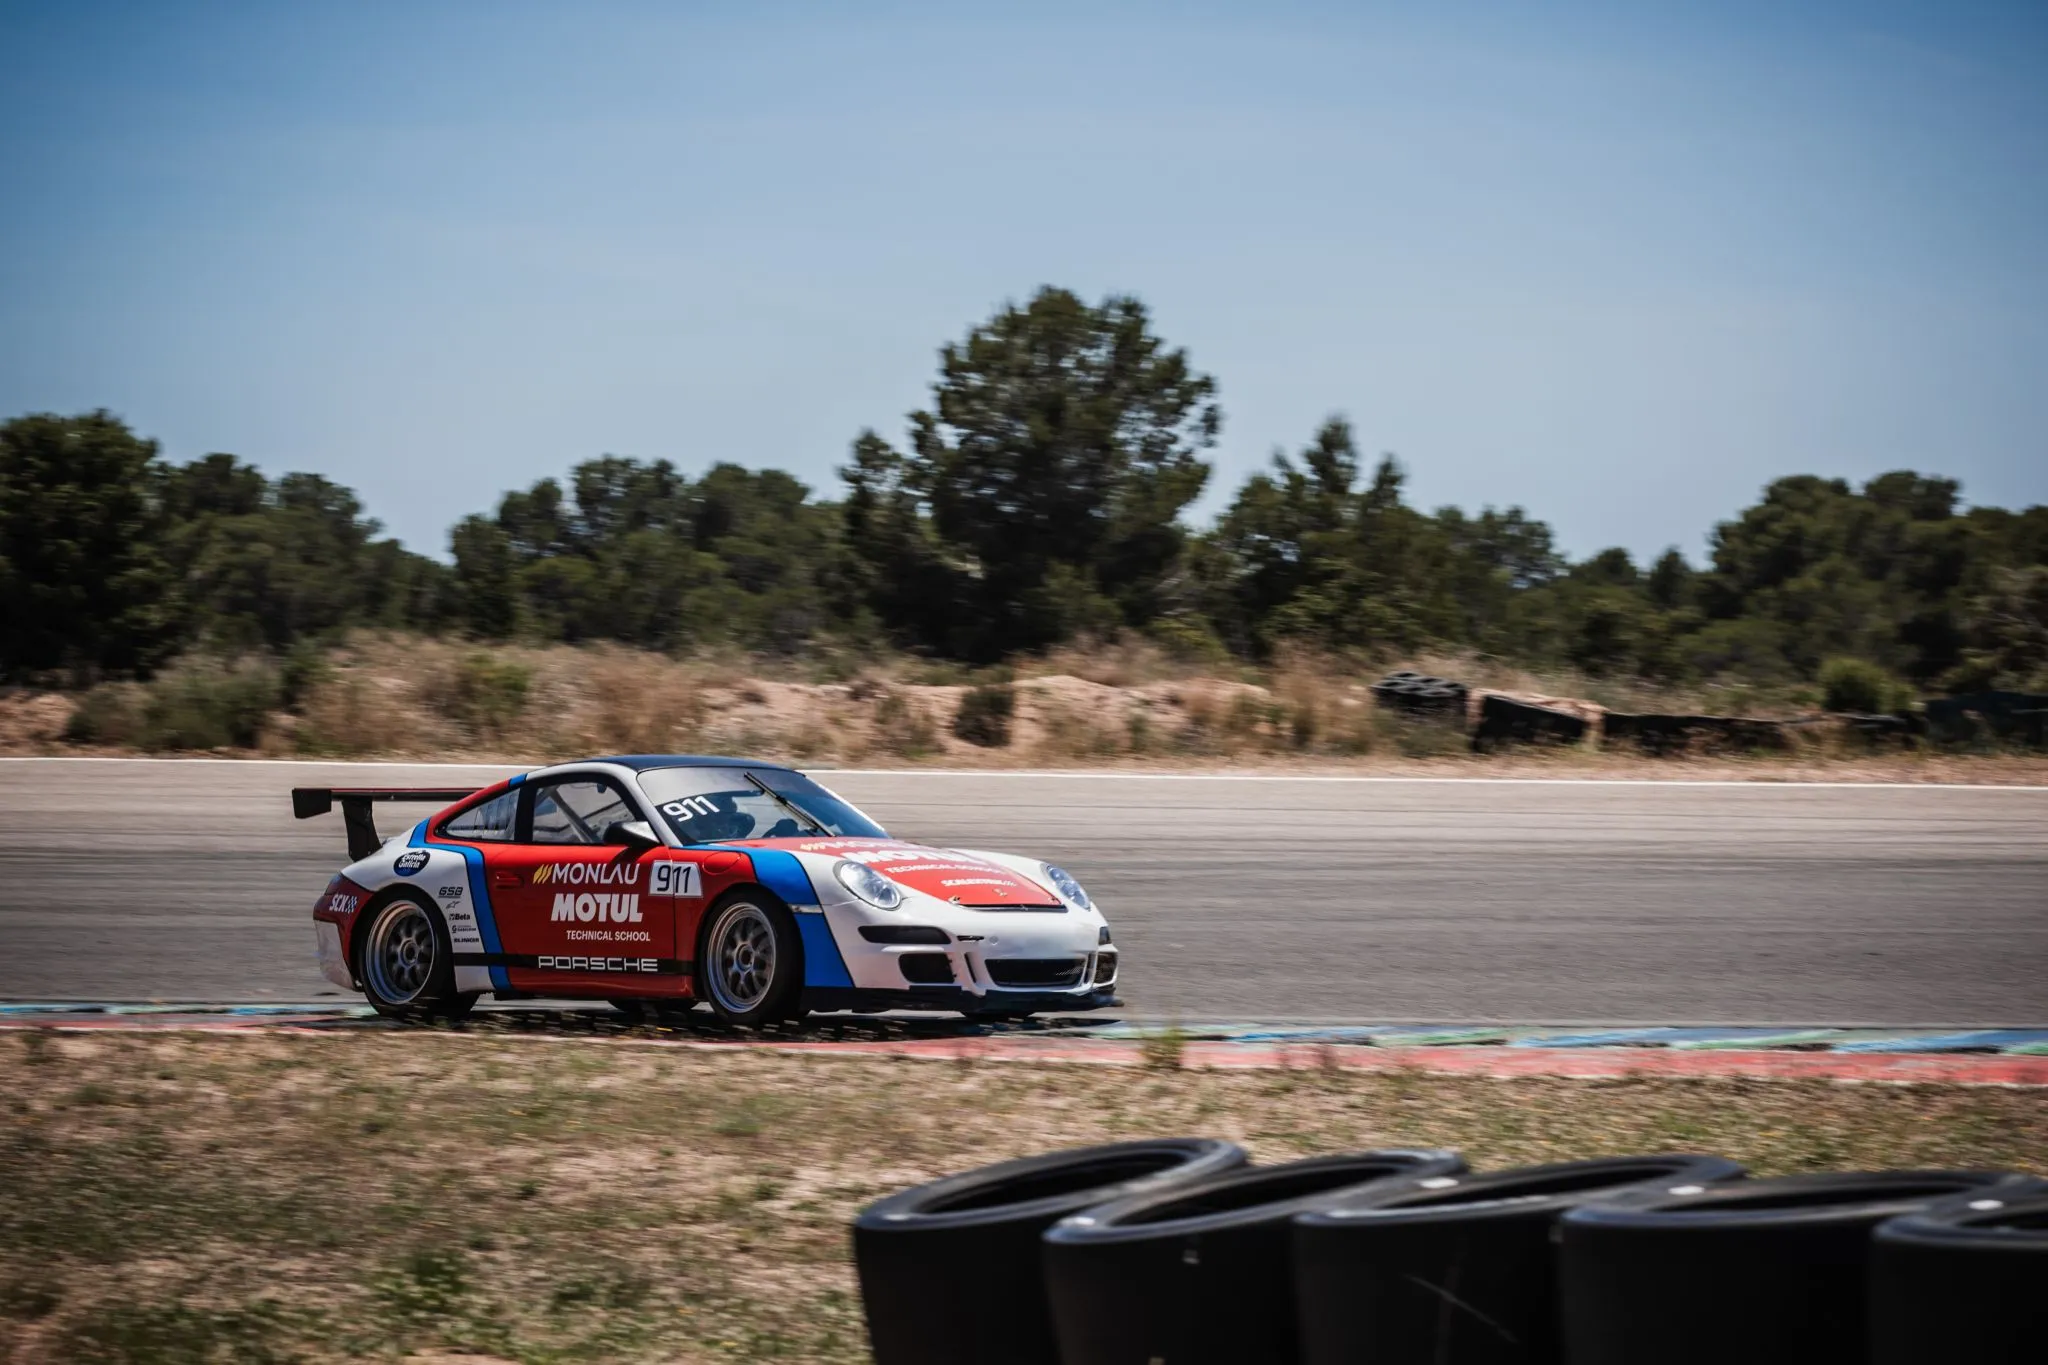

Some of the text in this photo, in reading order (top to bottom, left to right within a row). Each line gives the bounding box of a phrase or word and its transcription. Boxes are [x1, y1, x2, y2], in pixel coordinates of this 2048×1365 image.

[663, 795, 720, 822] 911
[552, 863, 641, 884] MONLAU
[657, 864, 692, 893] 911
[551, 893, 644, 923] MOTUL
[566, 930, 651, 942] TECHNICAL SCHOOL
[538, 956, 658, 972] PORSCHE
